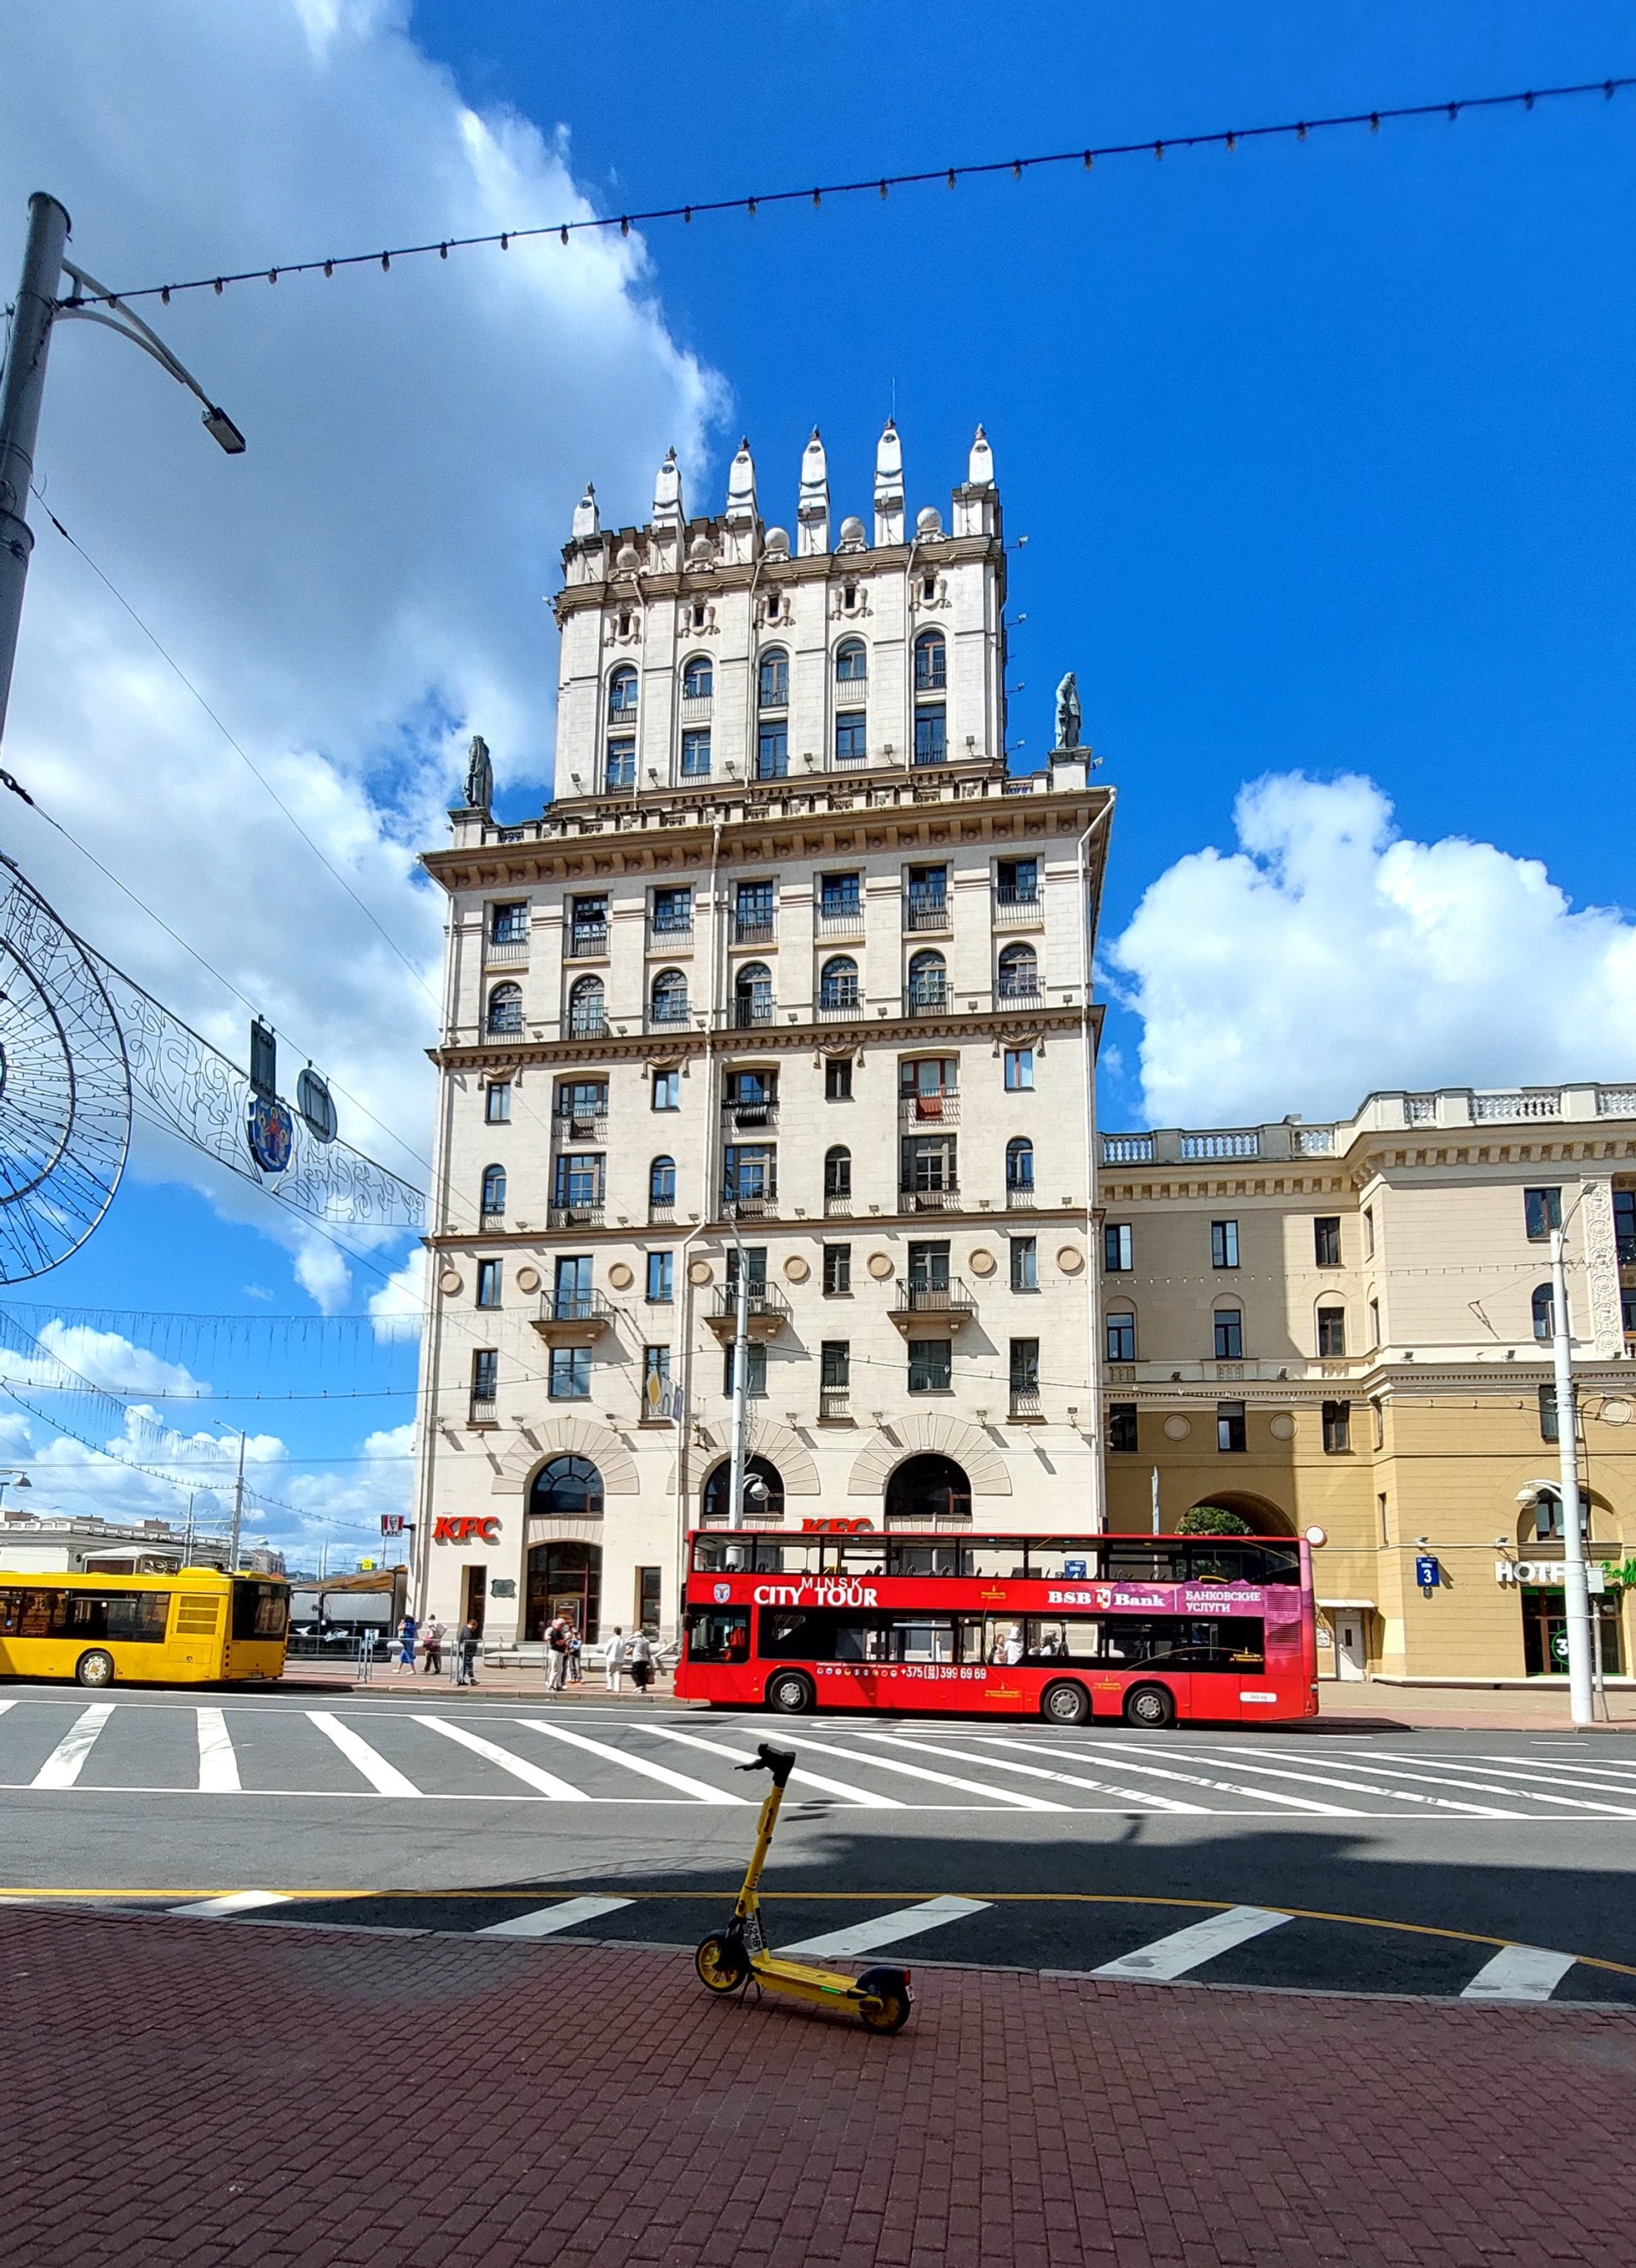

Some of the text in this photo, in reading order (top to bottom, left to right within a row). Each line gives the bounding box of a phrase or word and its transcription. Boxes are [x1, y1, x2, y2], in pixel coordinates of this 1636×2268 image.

[432, 1516, 498, 1538] KFC
[801, 1577, 861, 1590] MINSK
[1423, 1568, 1432, 1584] 3
[753, 1585, 878, 1607] CITY TOUR
[1047, 1590, 1167, 1607] BSB Bank
[1185, 1590, 1261, 1601] БАНКОВСКИЕ
[1185, 1602, 1230, 1613] УСЛУГИ
[901, 1665, 923, 1677] +375
[940, 1667, 958, 1678] 399
[960, 1668, 972, 1679] 69
[974, 1668, 987, 1679] 69
